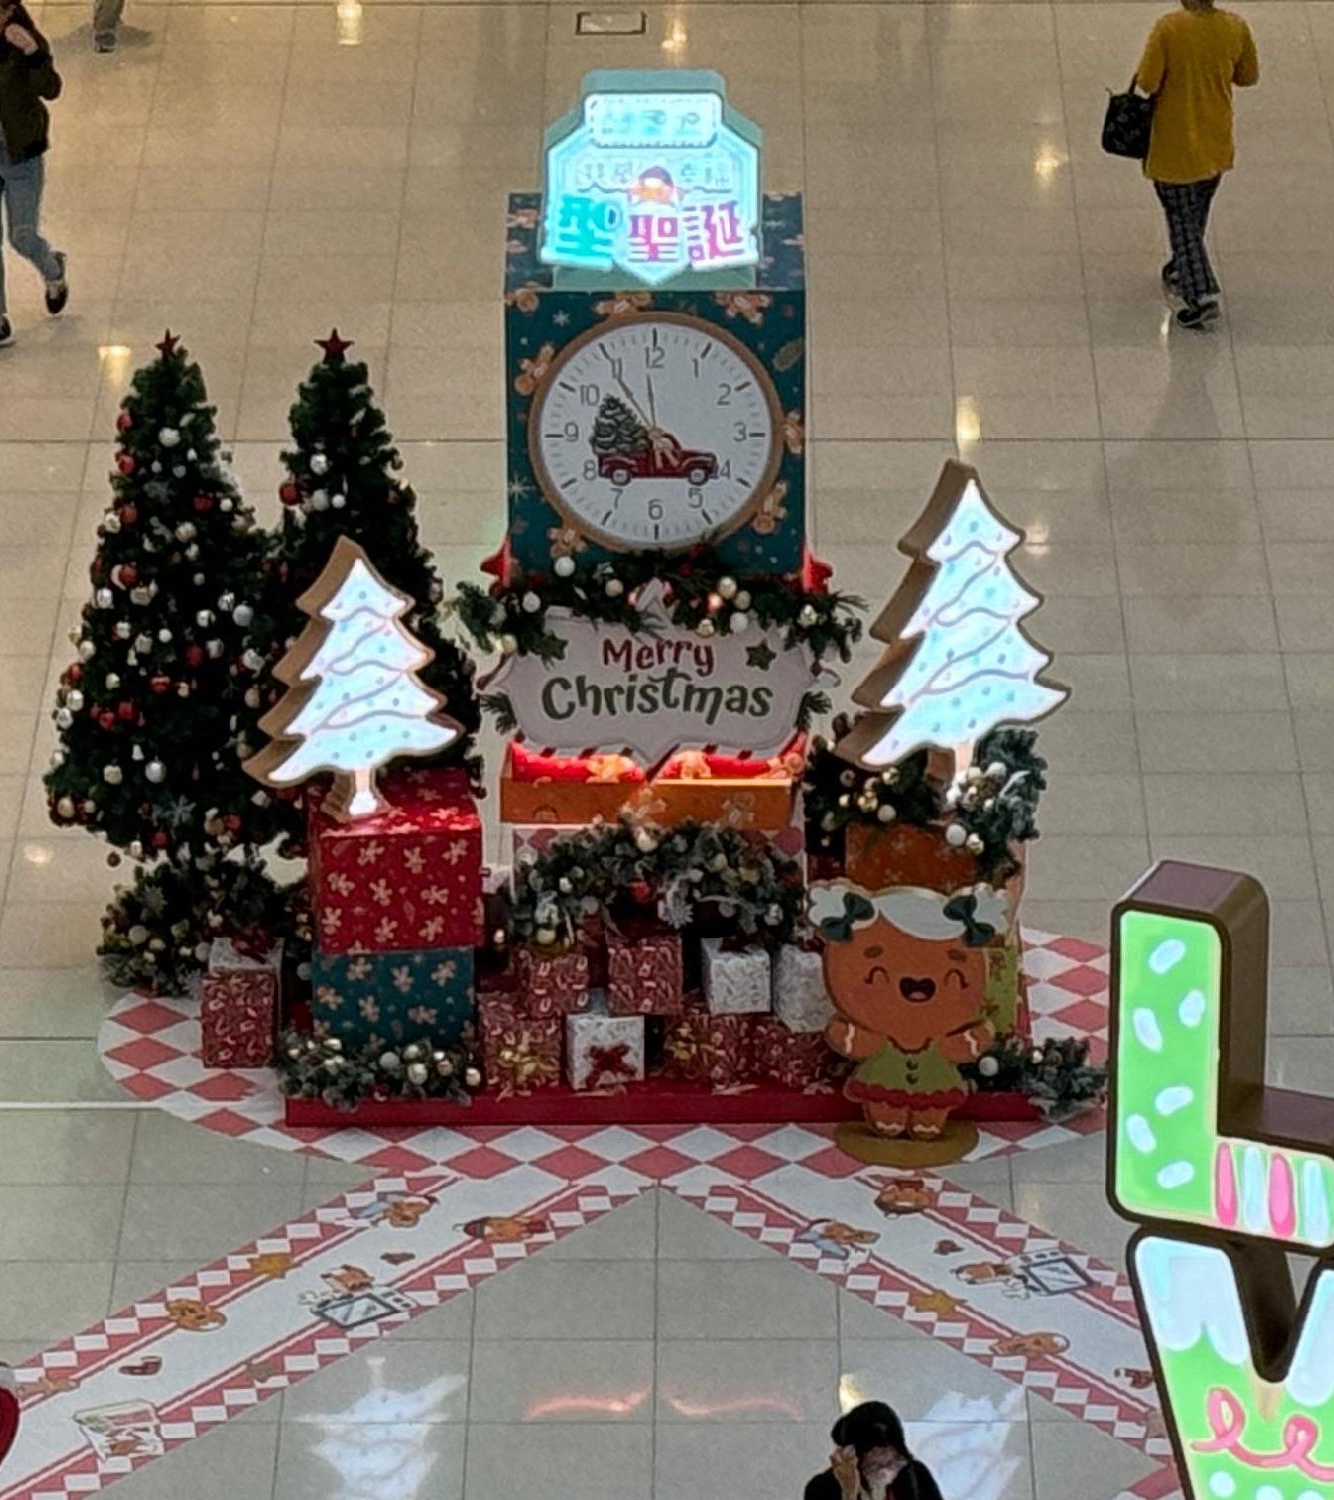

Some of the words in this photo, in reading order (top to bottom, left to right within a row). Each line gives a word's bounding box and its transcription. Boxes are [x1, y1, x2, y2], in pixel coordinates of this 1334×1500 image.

[645, 347, 666, 370] 12
[692, 357, 700, 379] 1
[579, 385, 600, 406] 10
[717, 384, 731, 406] 2
[564, 422, 579, 442] 9
[734, 422, 747, 442] 3
[583, 460, 598, 481] 8
[717, 460, 731, 480] 4
[611, 489, 624, 508] 7
[688, 489, 703, 508] 5
[648, 499, 664, 520] 6
[602, 638, 716, 677] Merry
[541, 669, 774, 726] Christmas
